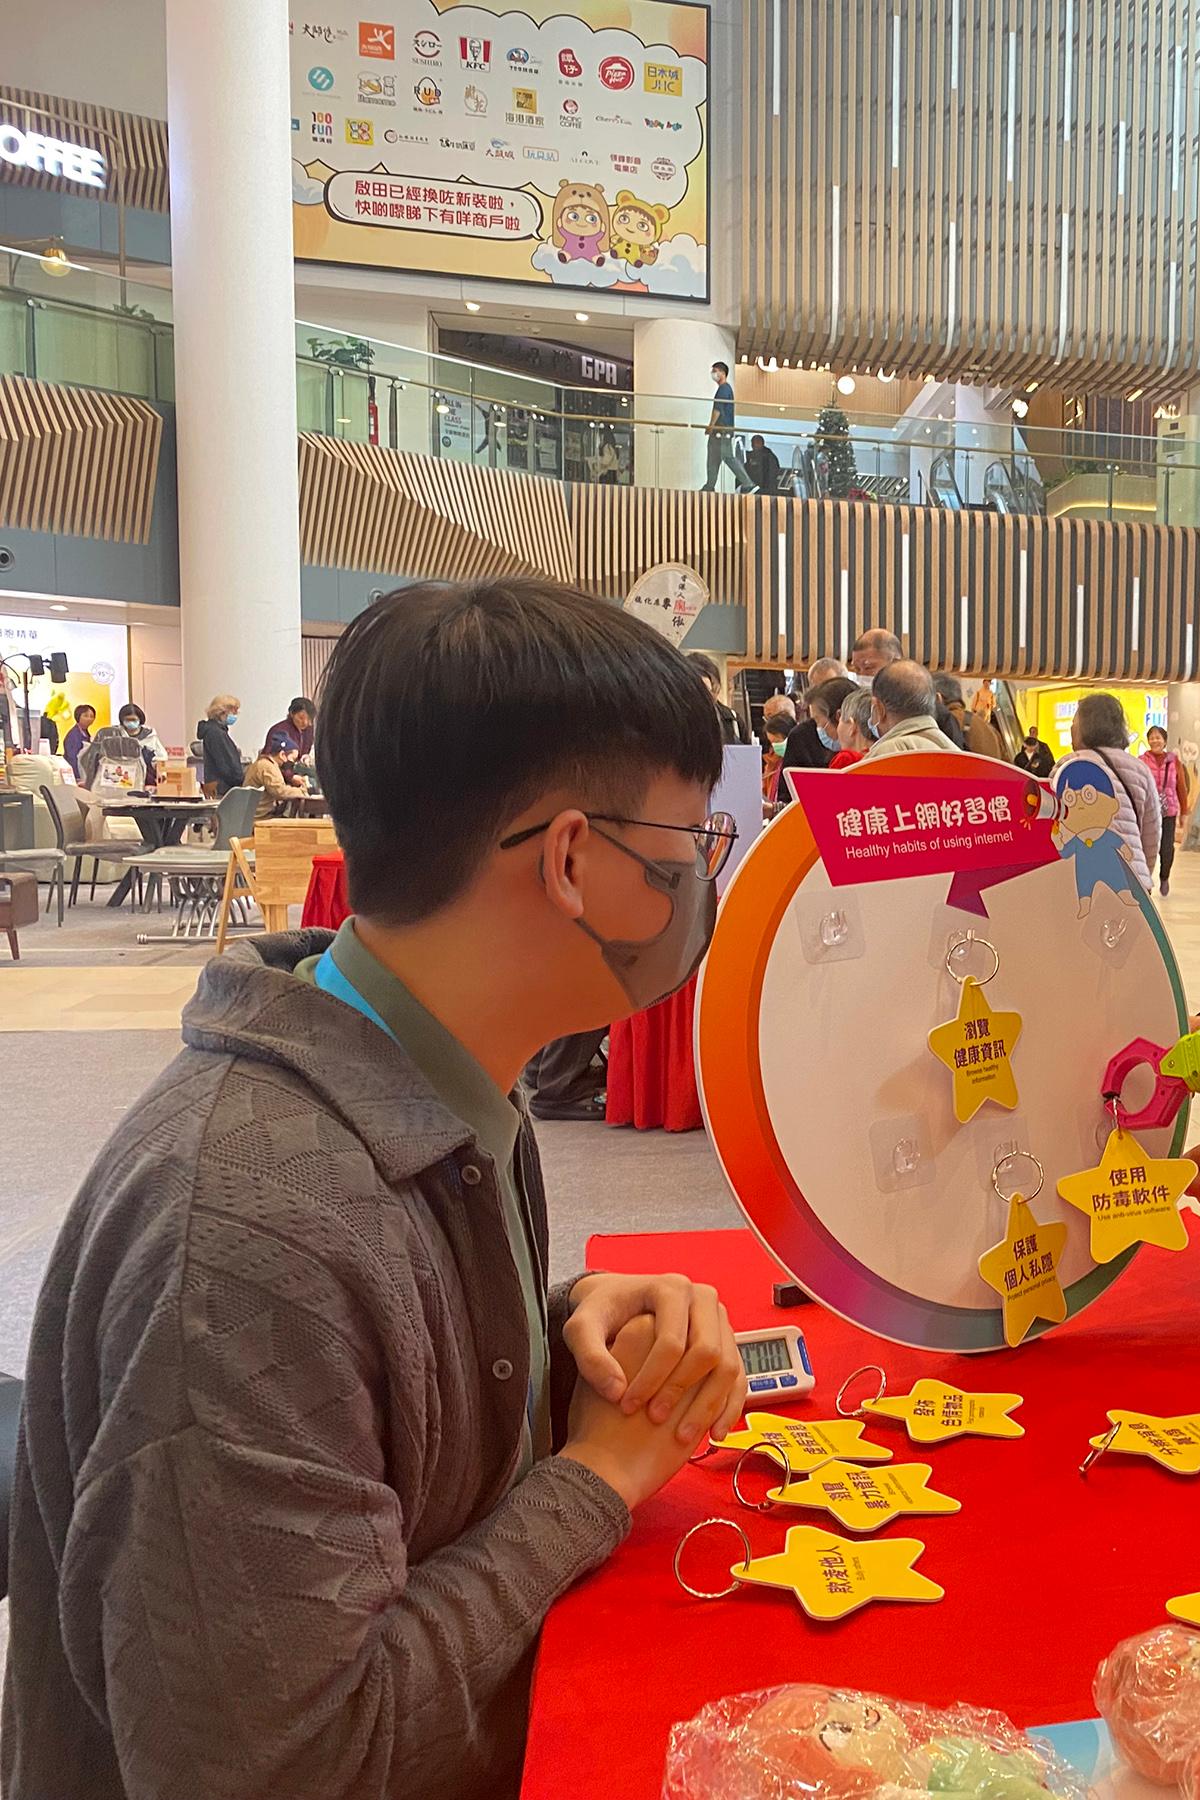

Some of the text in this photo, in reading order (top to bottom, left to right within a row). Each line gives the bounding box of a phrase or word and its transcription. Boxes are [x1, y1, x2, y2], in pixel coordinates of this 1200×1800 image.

[465, 60, 486, 71] KFC
[311, 111, 333, 124] 100
[836, 795, 1012, 838] 健康上網好習慣
[845, 830, 1014, 859] Healthy habits of using internet
[964, 1018, 991, 1040] 瀏覽
[953, 1040, 1007, 1069] 健康資訊
[1109, 1166, 1147, 1187] 使用
[1091, 1184, 1171, 1213] 防毒軟件
[1143, 1205, 1171, 1216] software
[1013, 1233, 1039, 1261] 保護
[1003, 1252, 1054, 1292] 個人私隱
[846, 1471, 891, 1510] 暴力資訊
[815, 1546, 855, 1594] 欺凌他人
